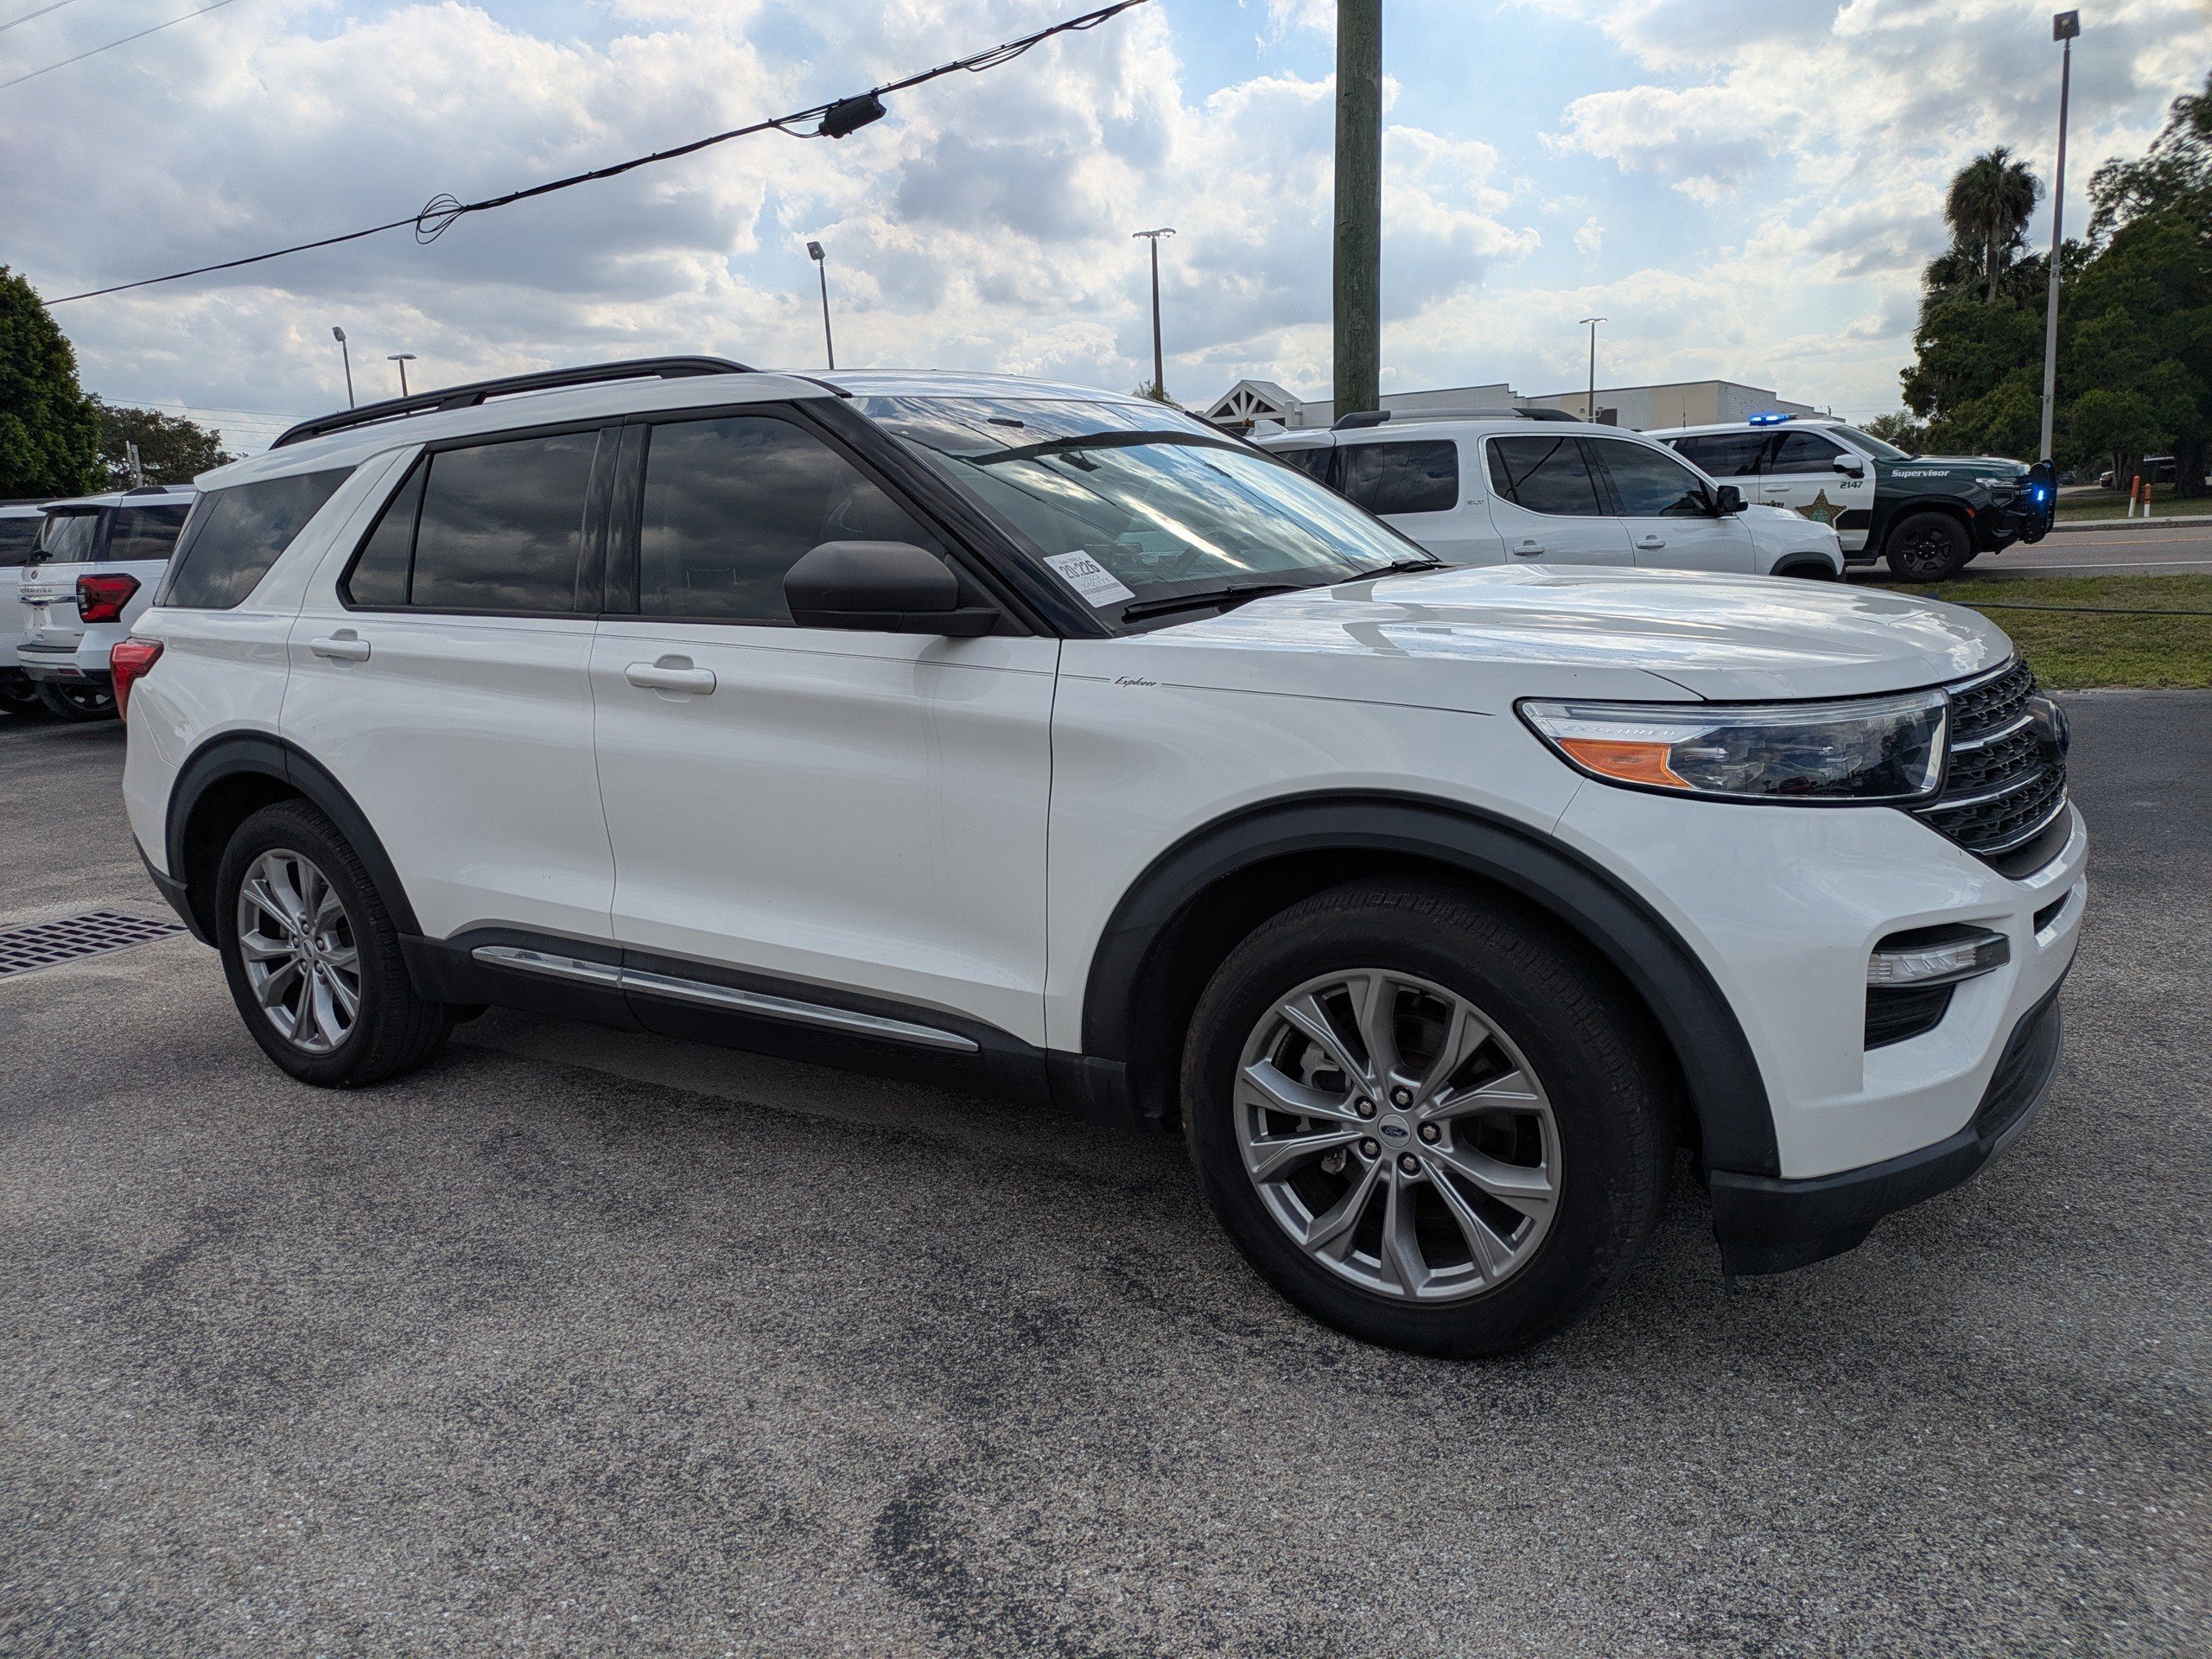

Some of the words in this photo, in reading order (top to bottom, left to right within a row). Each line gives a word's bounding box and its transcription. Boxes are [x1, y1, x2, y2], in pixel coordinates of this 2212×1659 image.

[1891, 469, 1950, 479] Supervisor
[1058, 559, 1101, 579] 20:226
[1080, 574, 1101, 582] 2023
[1114, 676, 1158, 689] Explorer
[1384, 1127, 1403, 1136] Ford
